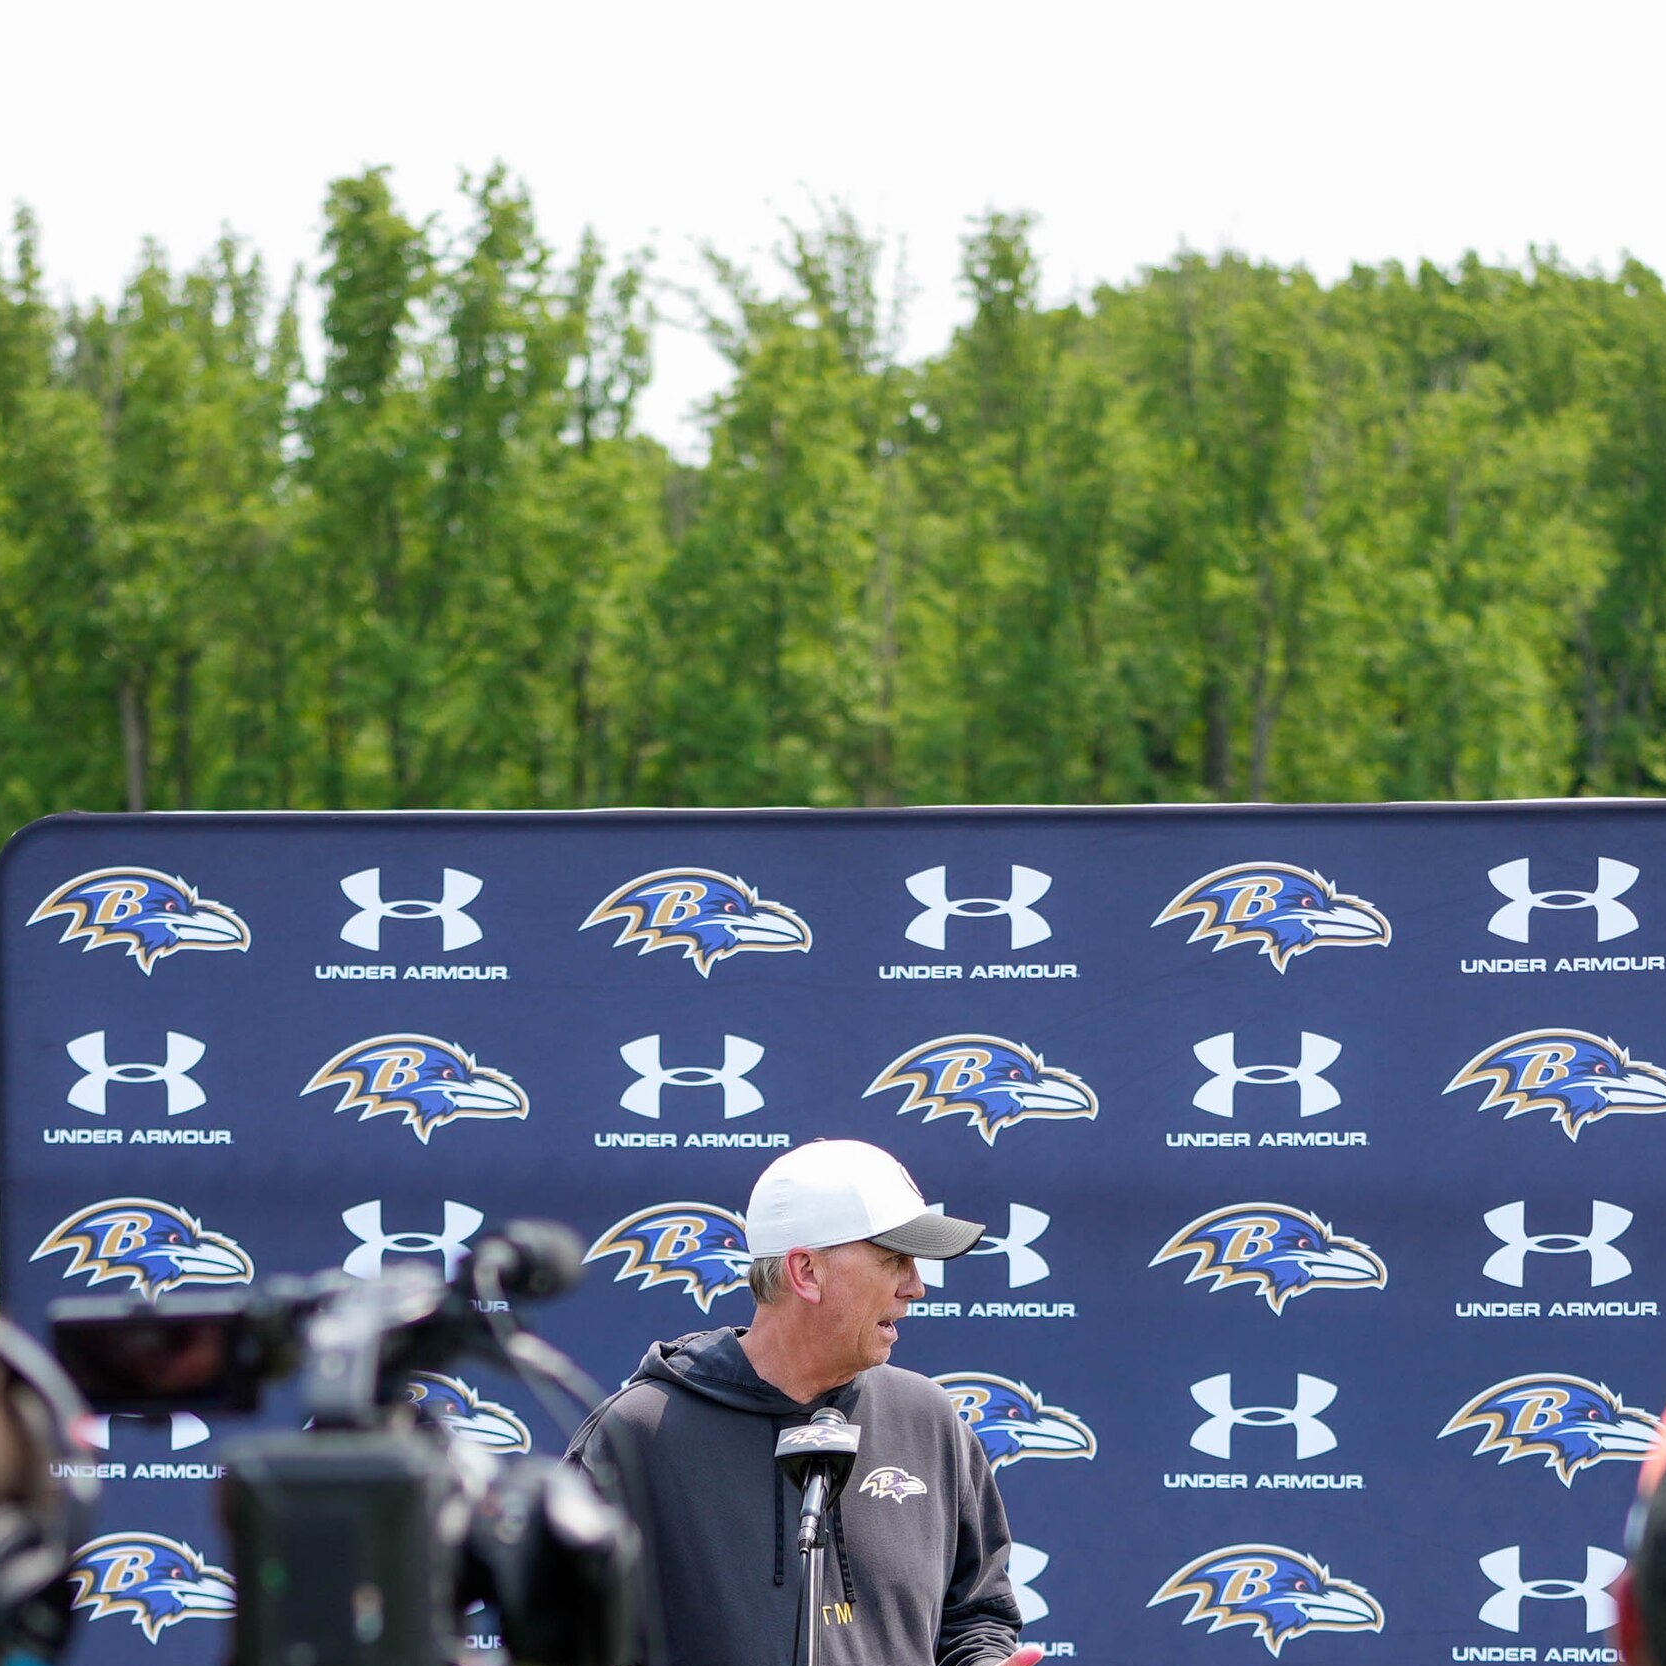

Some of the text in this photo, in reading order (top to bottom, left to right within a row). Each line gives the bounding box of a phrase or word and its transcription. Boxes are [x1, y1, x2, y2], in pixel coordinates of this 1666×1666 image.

[315, 965, 508, 980] UNDER ARMOUR
[879, 964, 1078, 980] UNDER ARMOUR
[1461, 956, 1666, 974] UNDER ARMOUR
[44, 1129, 232, 1145] UNDER ARMOUR
[594, 1133, 790, 1148] UNDER ARMOUR
[1166, 1131, 1367, 1147] UNDER ARMOUR
[906, 1302, 1075, 1318] DER ARMOUR
[1455, 1301, 1658, 1317] UNDER ARMOUR
[1163, 1473, 1363, 1489] UNDER ARMOUR
[1452, 1646, 1537, 1662] UNDER
